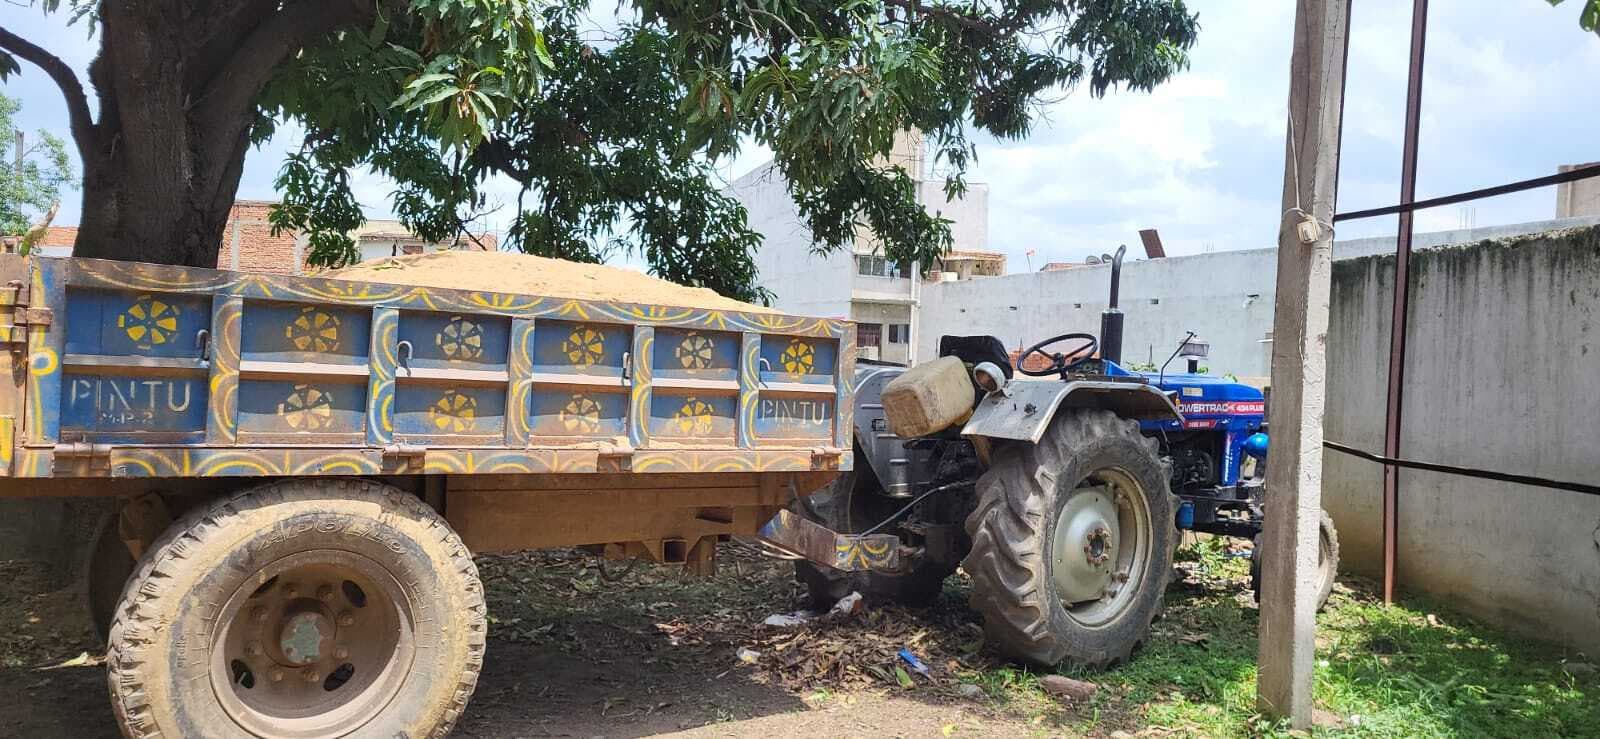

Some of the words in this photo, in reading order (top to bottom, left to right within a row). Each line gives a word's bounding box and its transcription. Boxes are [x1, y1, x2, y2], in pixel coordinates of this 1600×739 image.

[71, 379, 192, 412] PINTU
[1176, 403, 1235, 413] OWERTRACK
[762, 399, 825, 425] PINTU
